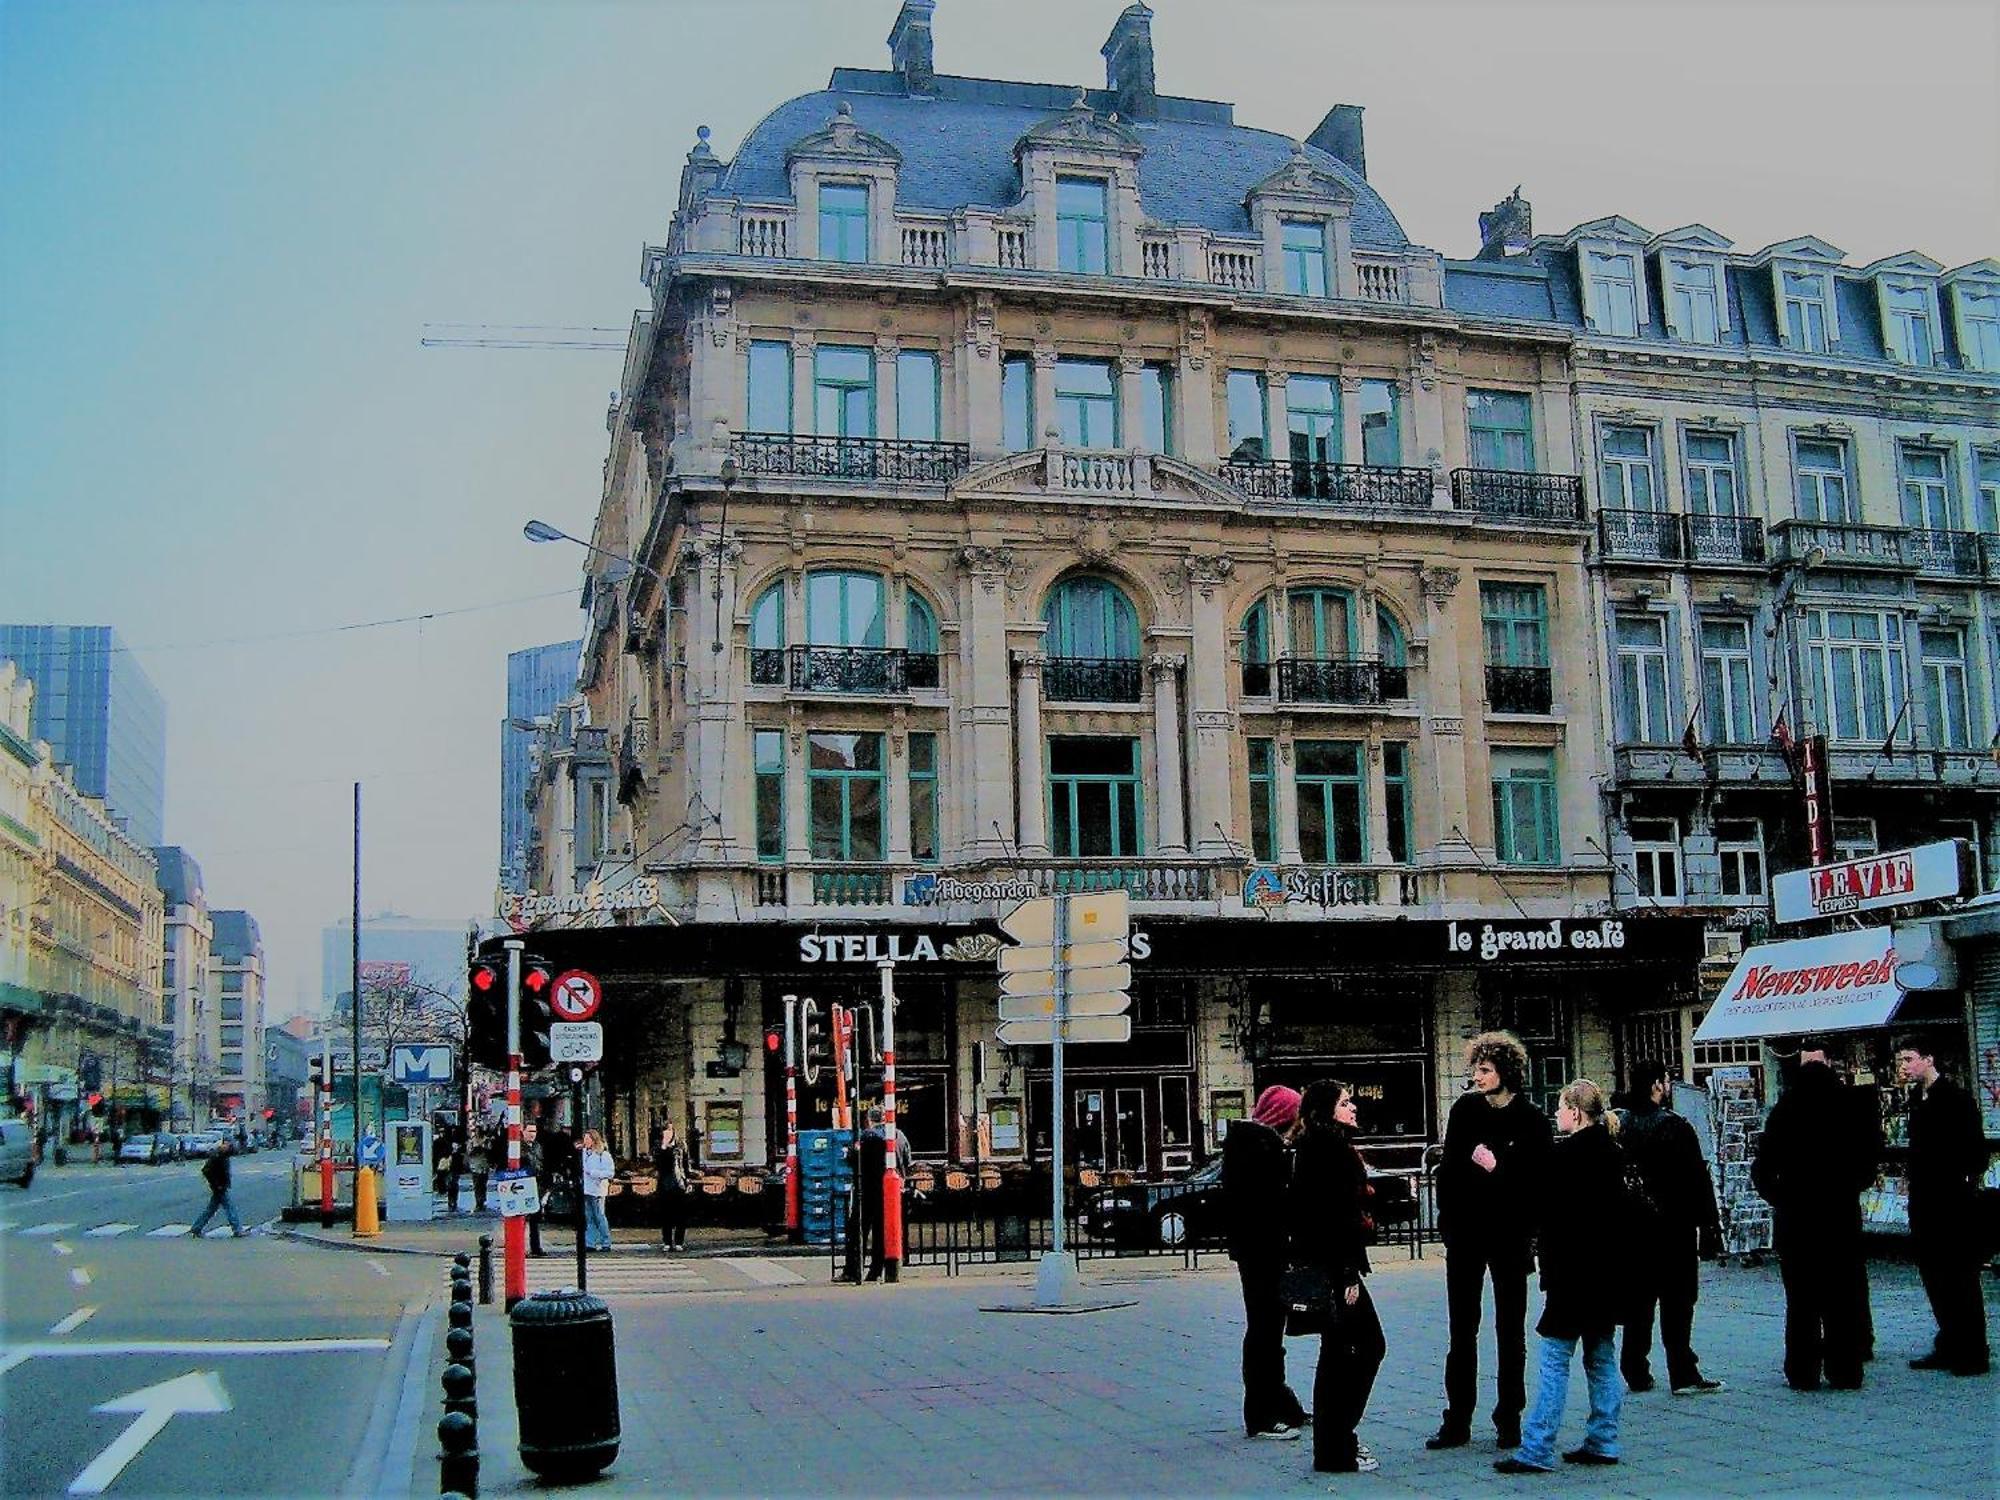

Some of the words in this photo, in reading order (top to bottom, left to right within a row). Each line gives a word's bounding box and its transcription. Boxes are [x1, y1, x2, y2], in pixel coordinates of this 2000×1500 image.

[943, 880, 1037, 900] Hoegaarden
[1287, 869, 1355, 907] Leffe
[1813, 864, 1850, 907] LE
[1855, 854, 1911, 898] VIF
[800, 934, 939, 962] STELLA
[1448, 921, 1472, 951] le
[1480, 919, 1563, 960] grand
[1571, 919, 1625, 949] café
[1732, 947, 1899, 1002] Newsweek
[395, 1048, 450, 1079] M
[815, 1098, 828, 1112] le
